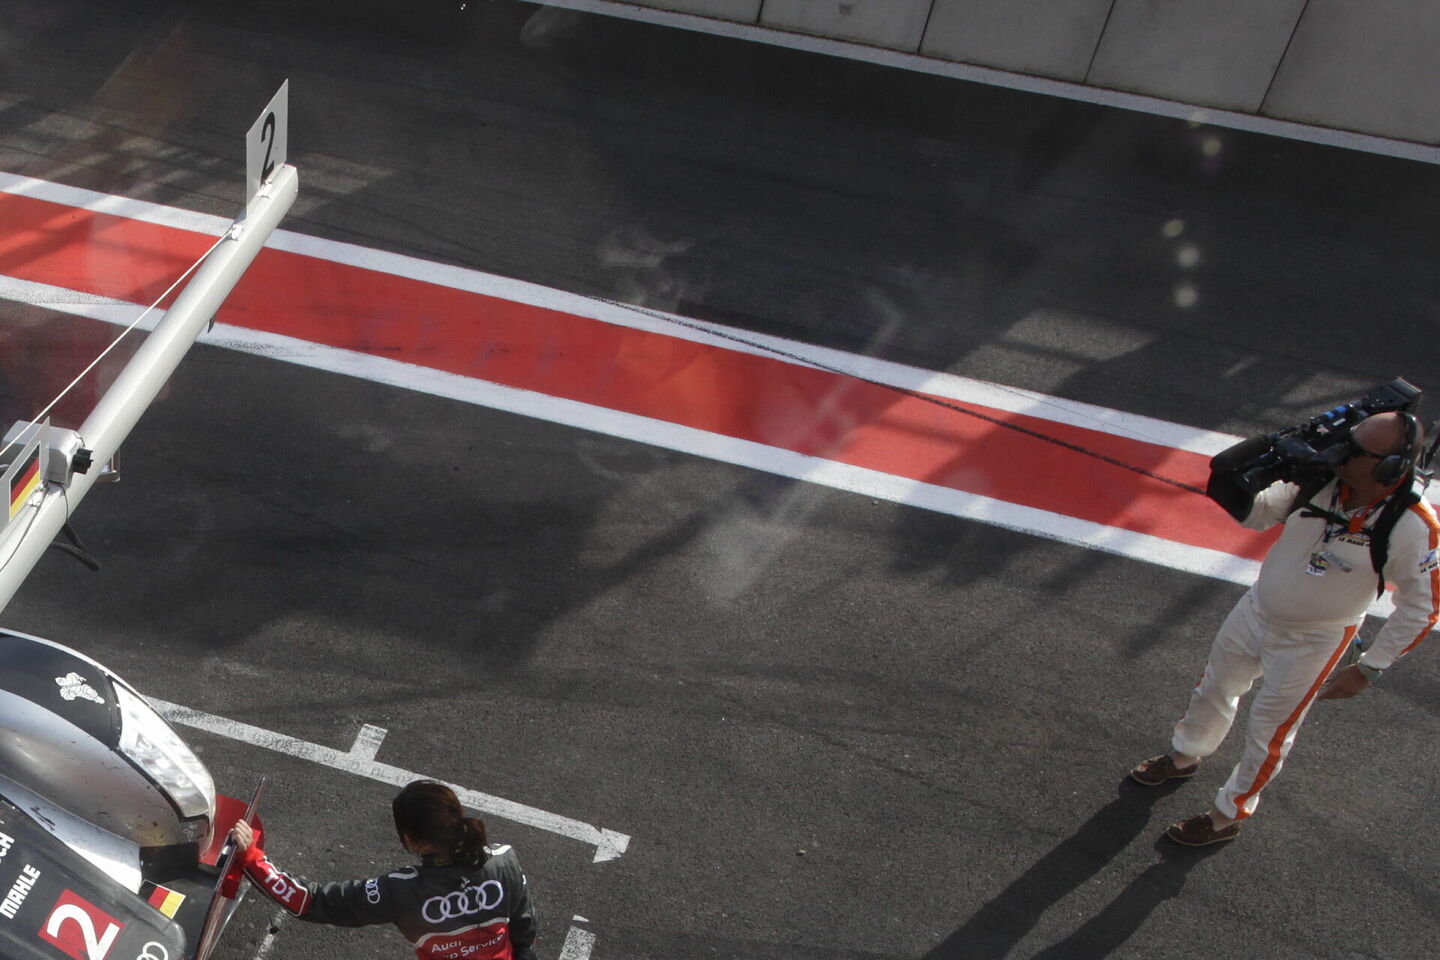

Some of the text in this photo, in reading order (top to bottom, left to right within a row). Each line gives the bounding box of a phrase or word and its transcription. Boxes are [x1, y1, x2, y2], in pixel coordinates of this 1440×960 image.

[260, 111, 276, 188] 2
[264, 868, 296, 902] TDI
[431, 940, 462, 953] Audi
